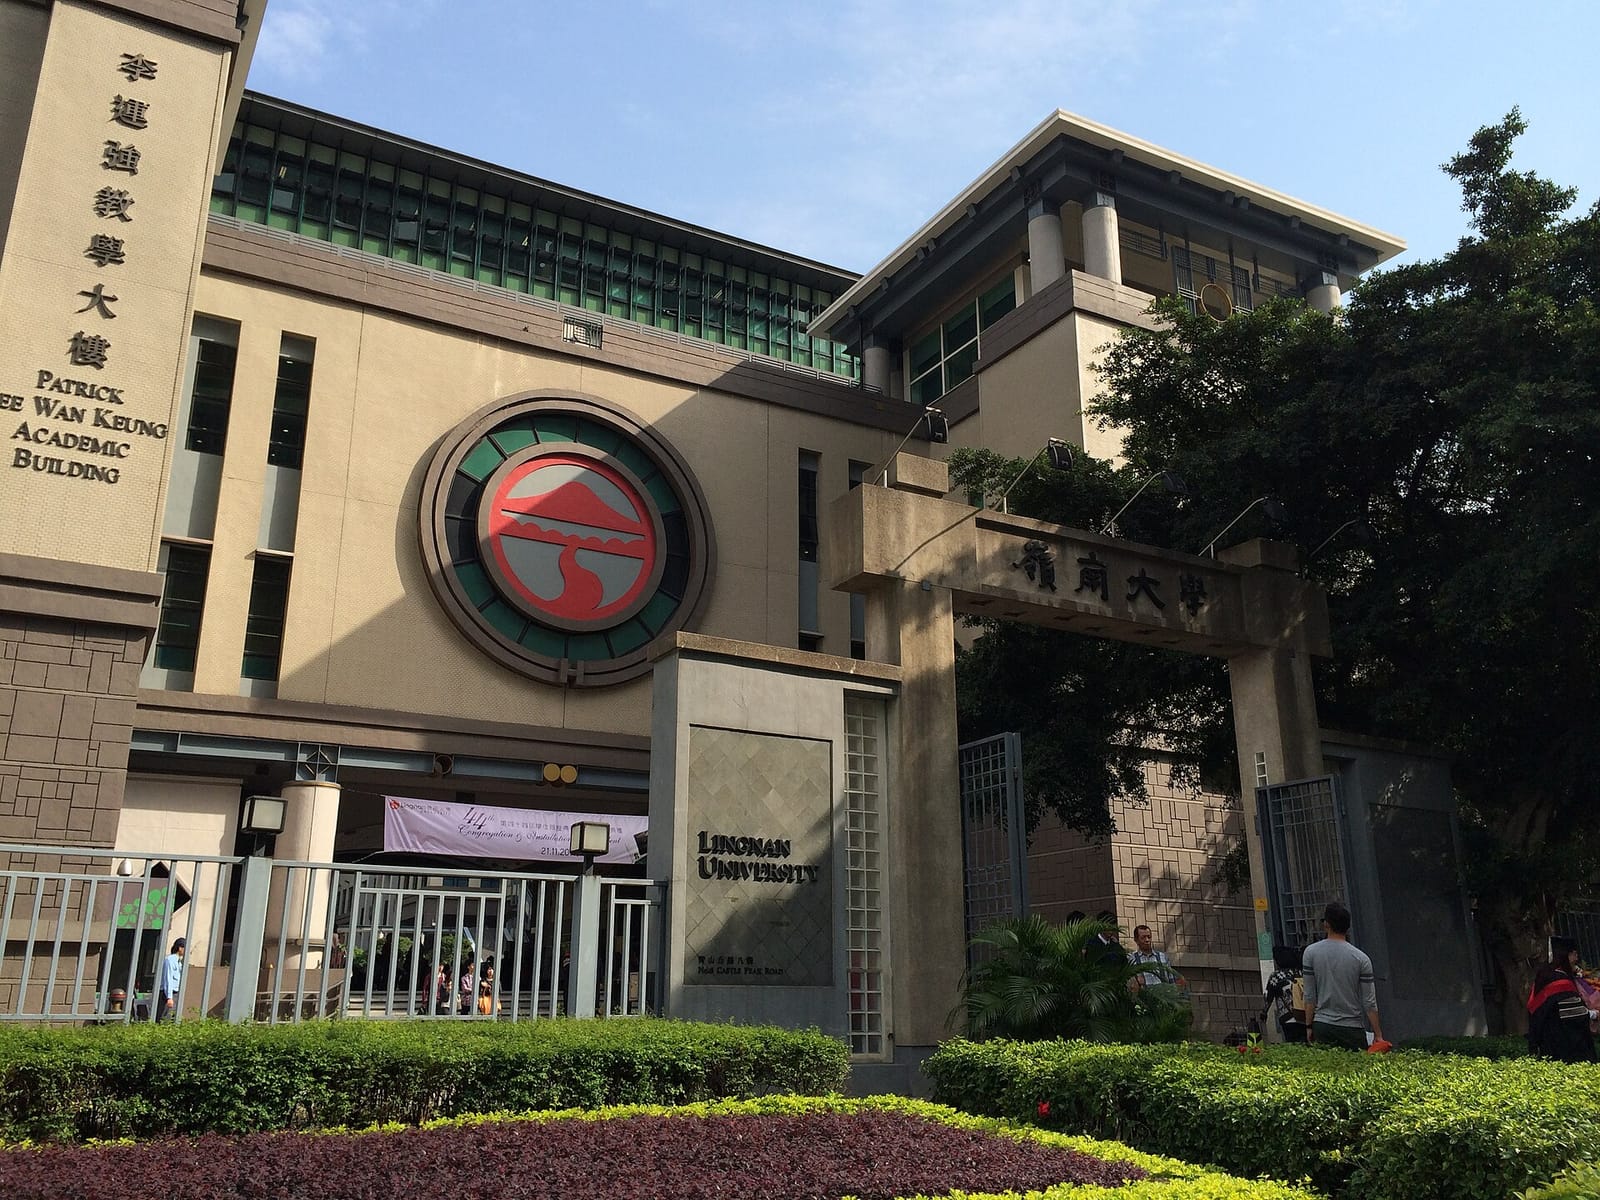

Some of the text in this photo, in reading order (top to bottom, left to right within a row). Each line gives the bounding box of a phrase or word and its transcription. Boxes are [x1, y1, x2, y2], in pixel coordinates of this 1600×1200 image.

[67, 52, 158, 370] 李運強教學大樓
[35, 369, 124, 404] PATRICK
[0, 393, 168, 439] EE WAN KEUNG
[10, 421, 131, 458] ACADEMIC
[12, 447, 120, 484] BUILDING
[457, 824, 513, 842] Congregation
[697, 830, 792, 859] LINGNAN
[697, 855, 819, 884] UNIVERSITY
